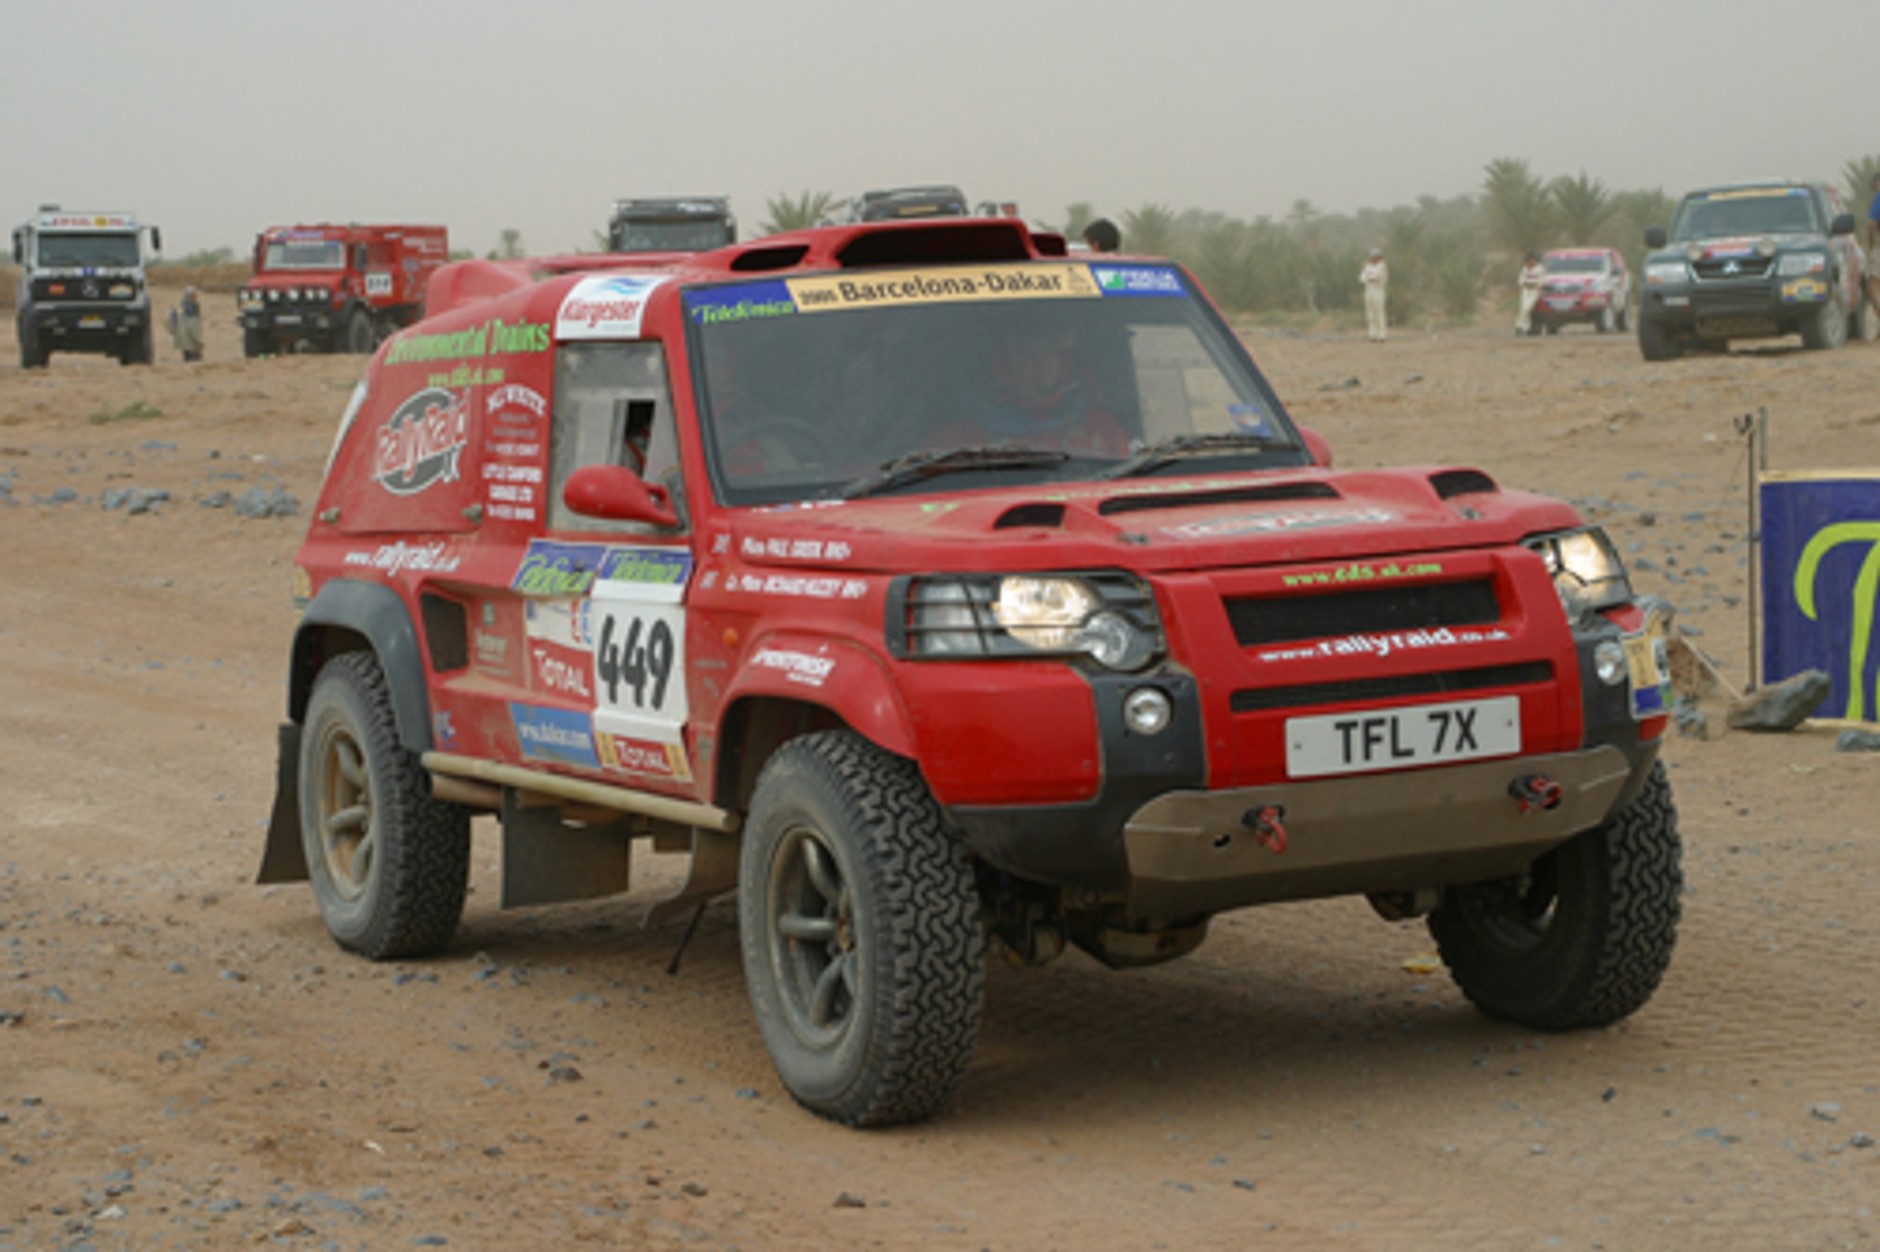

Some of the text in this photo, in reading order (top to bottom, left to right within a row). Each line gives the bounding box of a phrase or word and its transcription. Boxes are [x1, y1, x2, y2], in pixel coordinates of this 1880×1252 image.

[838, 270, 1062, 302] Barcelona-Dakar
[598, 613, 675, 712] 449
[1334, 707, 1479, 764] TFL 7X
